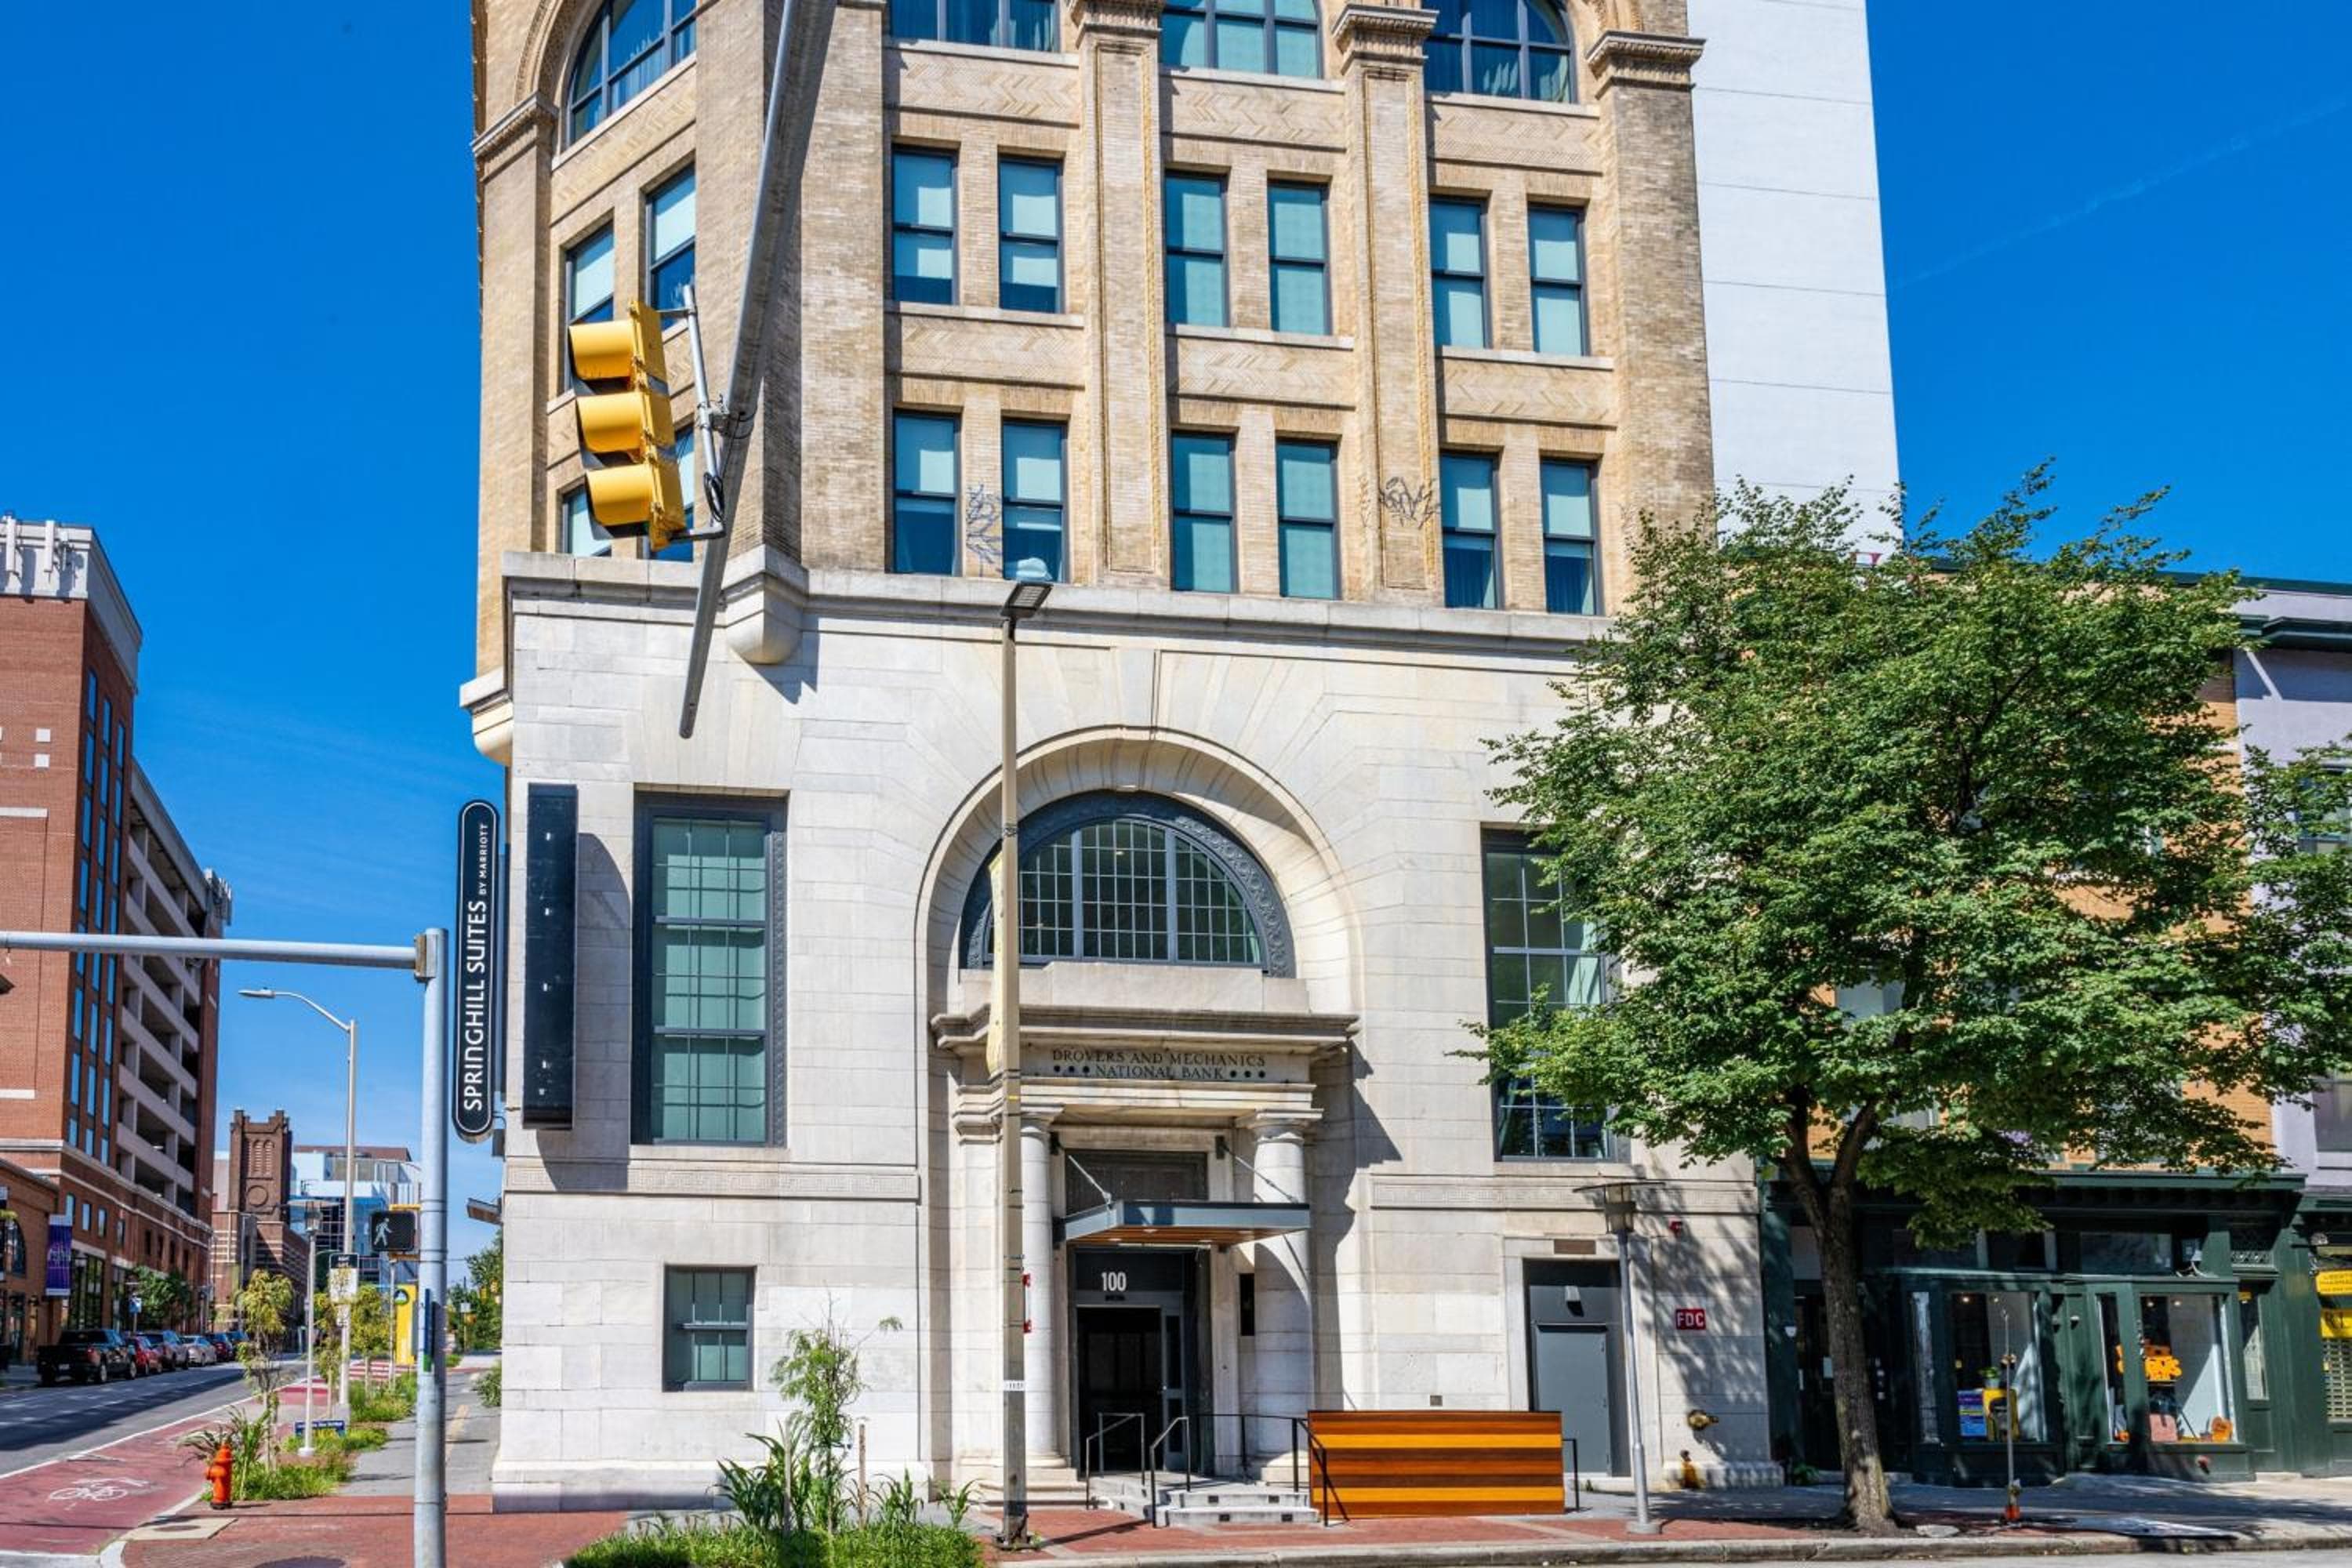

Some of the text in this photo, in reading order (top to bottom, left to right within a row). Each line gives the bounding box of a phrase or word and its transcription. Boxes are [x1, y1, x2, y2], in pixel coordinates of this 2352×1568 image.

[464, 823, 488, 1112] SPRINGHILL SUITES BY MARRIOTT
[1053, 1049, 1265, 1067] DROVERS AND MECHANICS
[1095, 1064, 1225, 1080] NATIONAL BANK
[1102, 1271, 1127, 1291] 100
[1677, 1312, 1704, 1327] FDC
